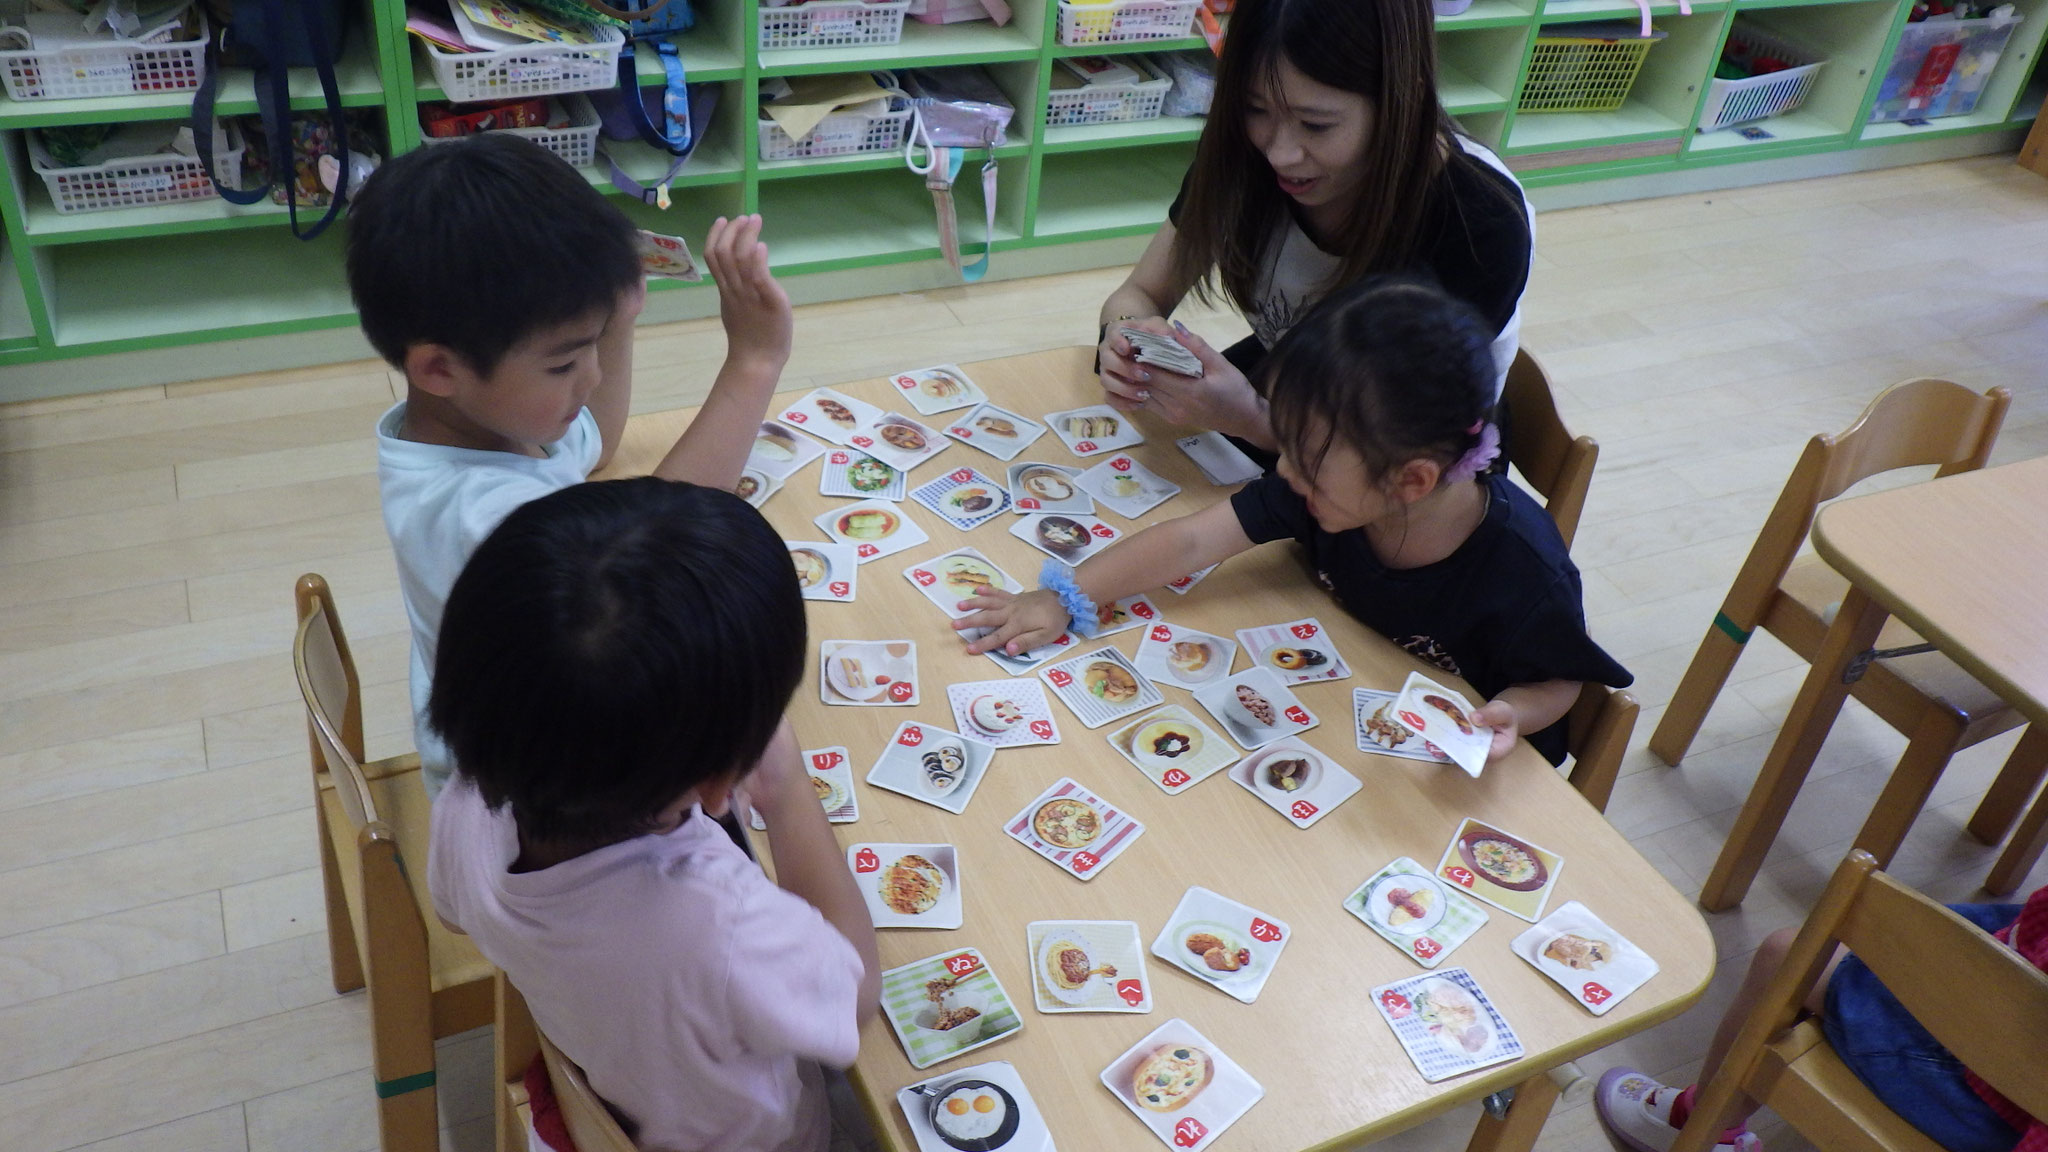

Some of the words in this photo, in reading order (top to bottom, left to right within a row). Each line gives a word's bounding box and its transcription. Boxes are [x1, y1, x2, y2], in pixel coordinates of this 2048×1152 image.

[955, 473, 967, 482] ひ
[1027, 499, 1035, 508] し
[1093, 528, 1107, 537] ん
[1153, 631, 1170, 639] も
[1298, 627, 1312, 637] え
[1053, 673, 1070, 685] に
[894, 685, 911, 696] る
[1286, 711, 1303, 720] よ
[1407, 713, 1423, 726] へ
[1033, 722, 1050, 733] ろ
[902, 733, 920, 742] を
[819, 754, 831, 768] り
[1168, 771, 1185, 783] ゆ
[1294, 801, 1314, 816] ほ
[859, 858, 876, 868] と
[1076, 853, 1093, 866] ま
[1453, 869, 1472, 884] わ
[1254, 923, 1274, 936] か
[1416, 938, 1436, 953] あ
[951, 958, 973, 973] ぬ
[1586, 985, 1606, 999] さ
[1388, 998, 1407, 1013] や
[1178, 1120, 1202, 1139] れ
